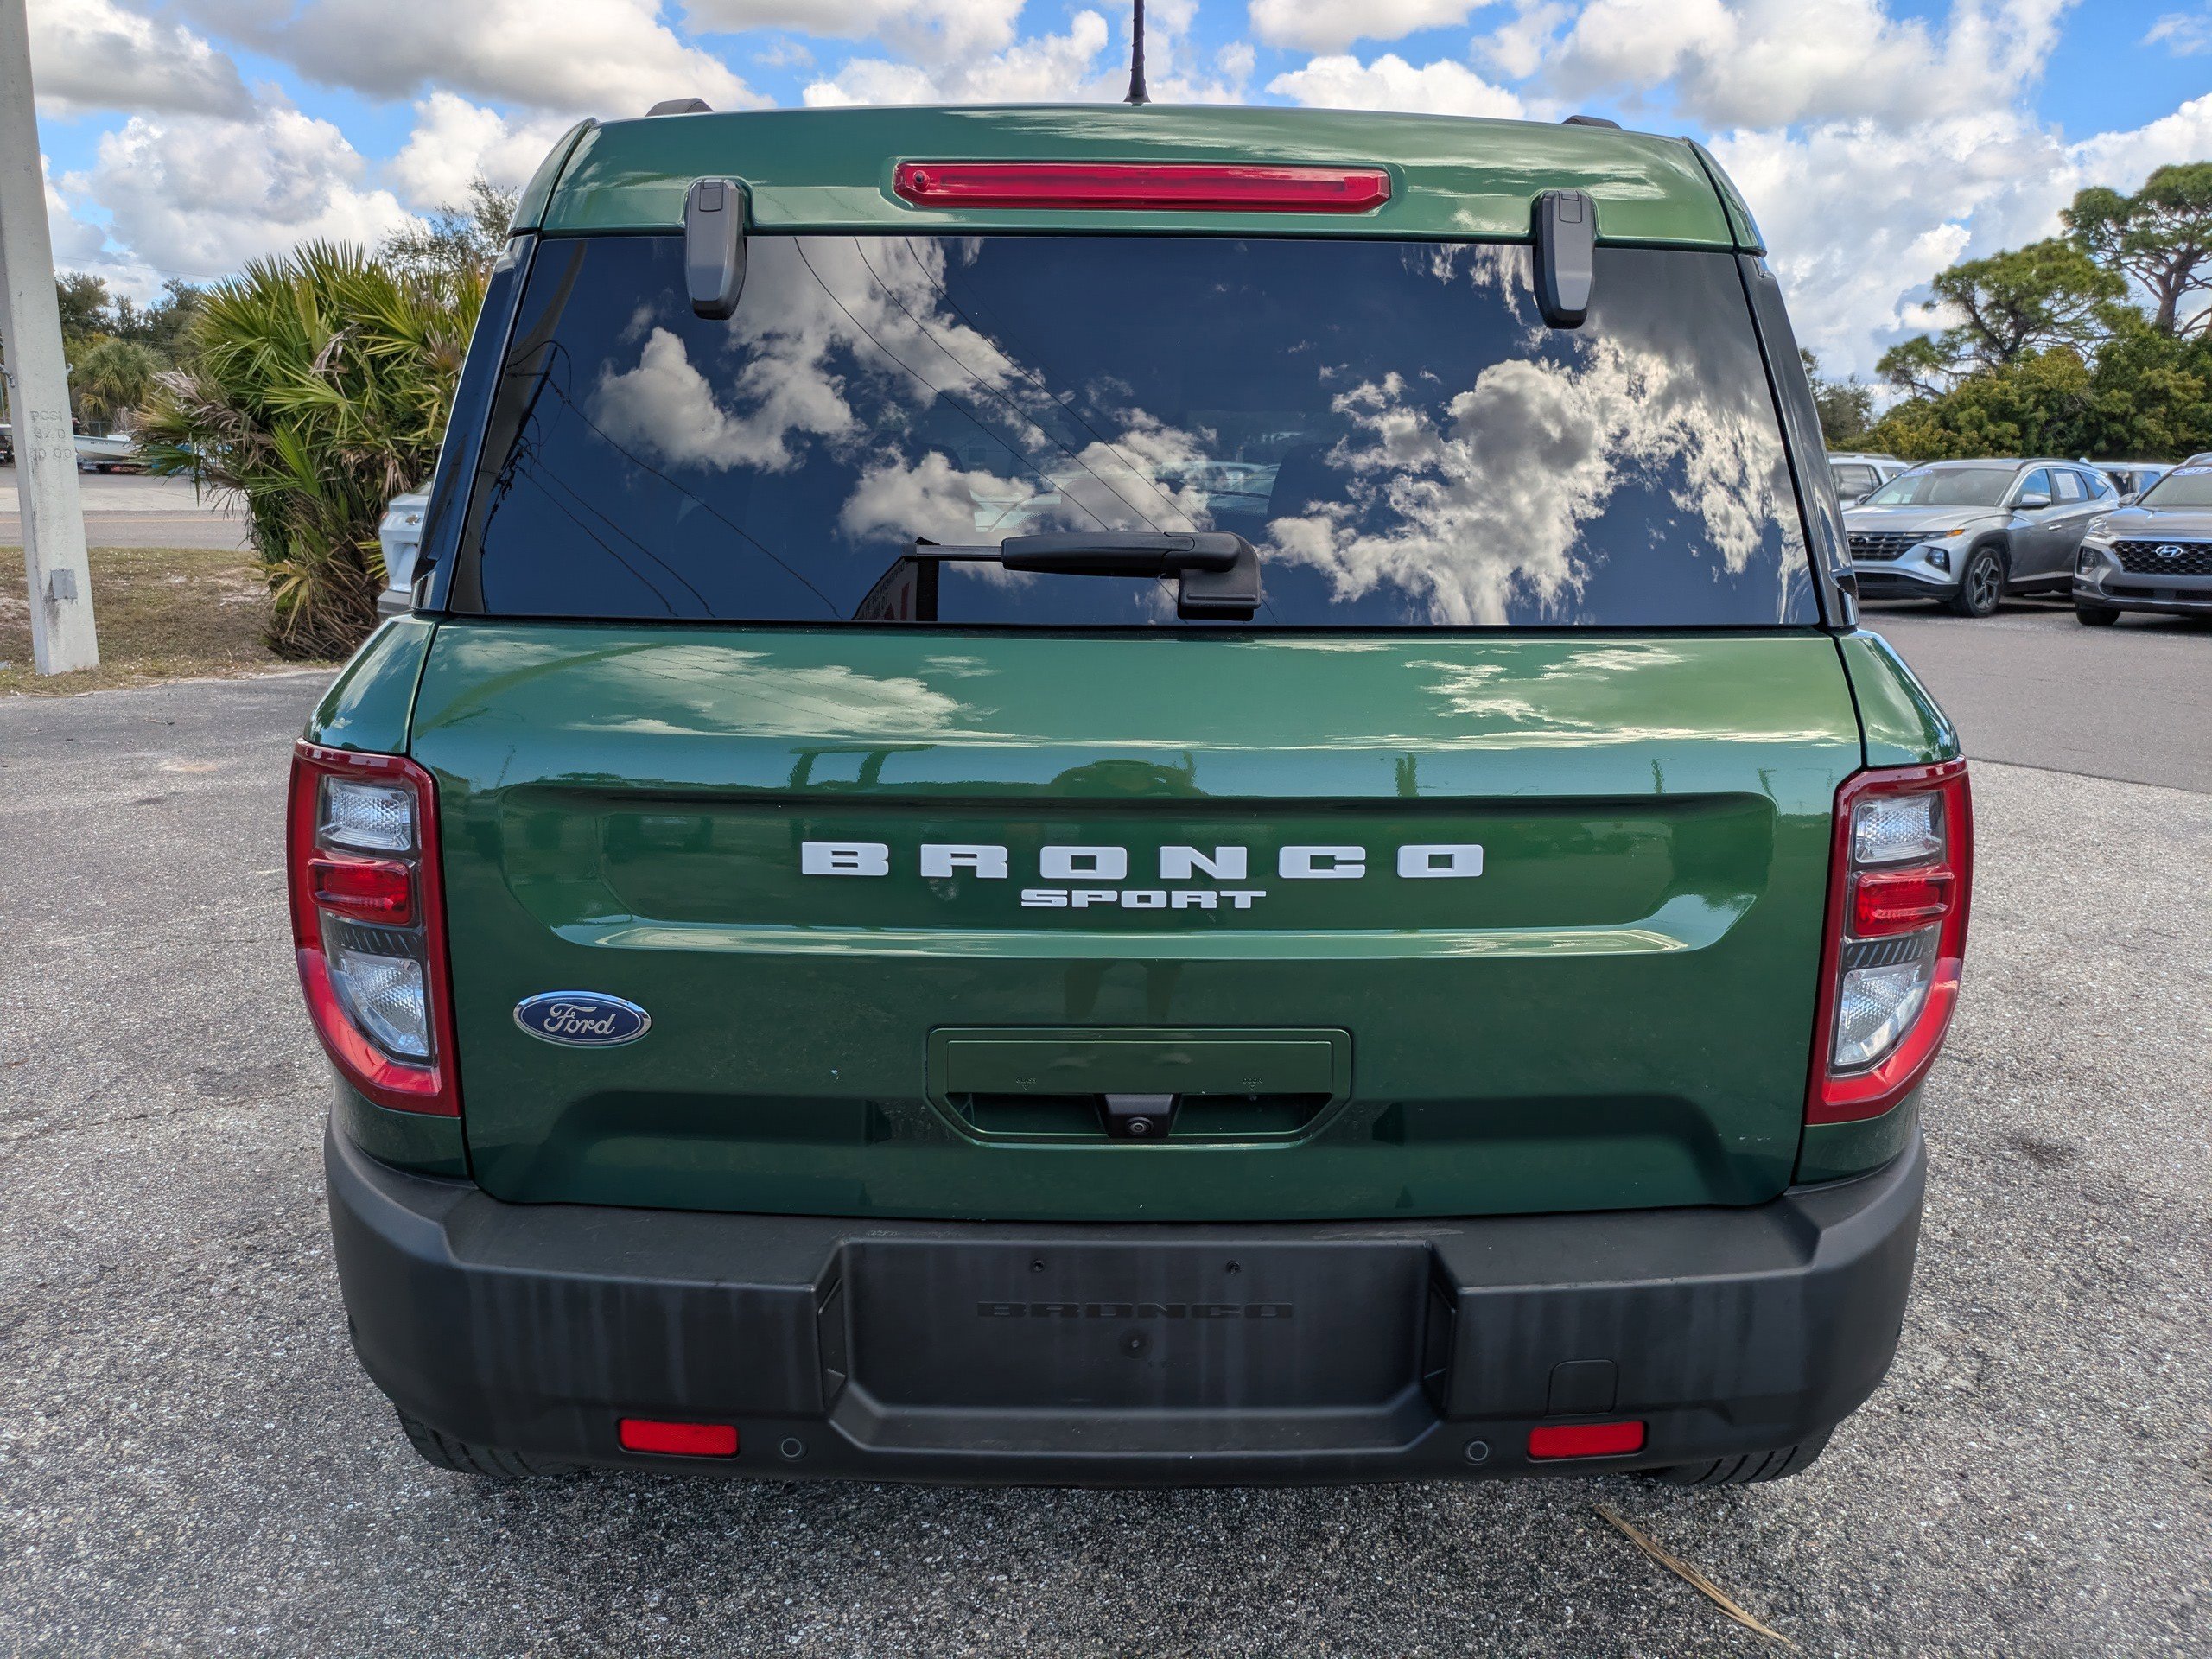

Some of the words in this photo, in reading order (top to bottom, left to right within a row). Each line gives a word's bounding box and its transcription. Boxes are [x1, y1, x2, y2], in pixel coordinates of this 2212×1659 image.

[801, 842, 1484, 879] BRONCO
[1020, 888, 1267, 909] SPORT
[543, 1003, 617, 1035] Ford
[976, 1302, 1293, 1319] BRONCO
